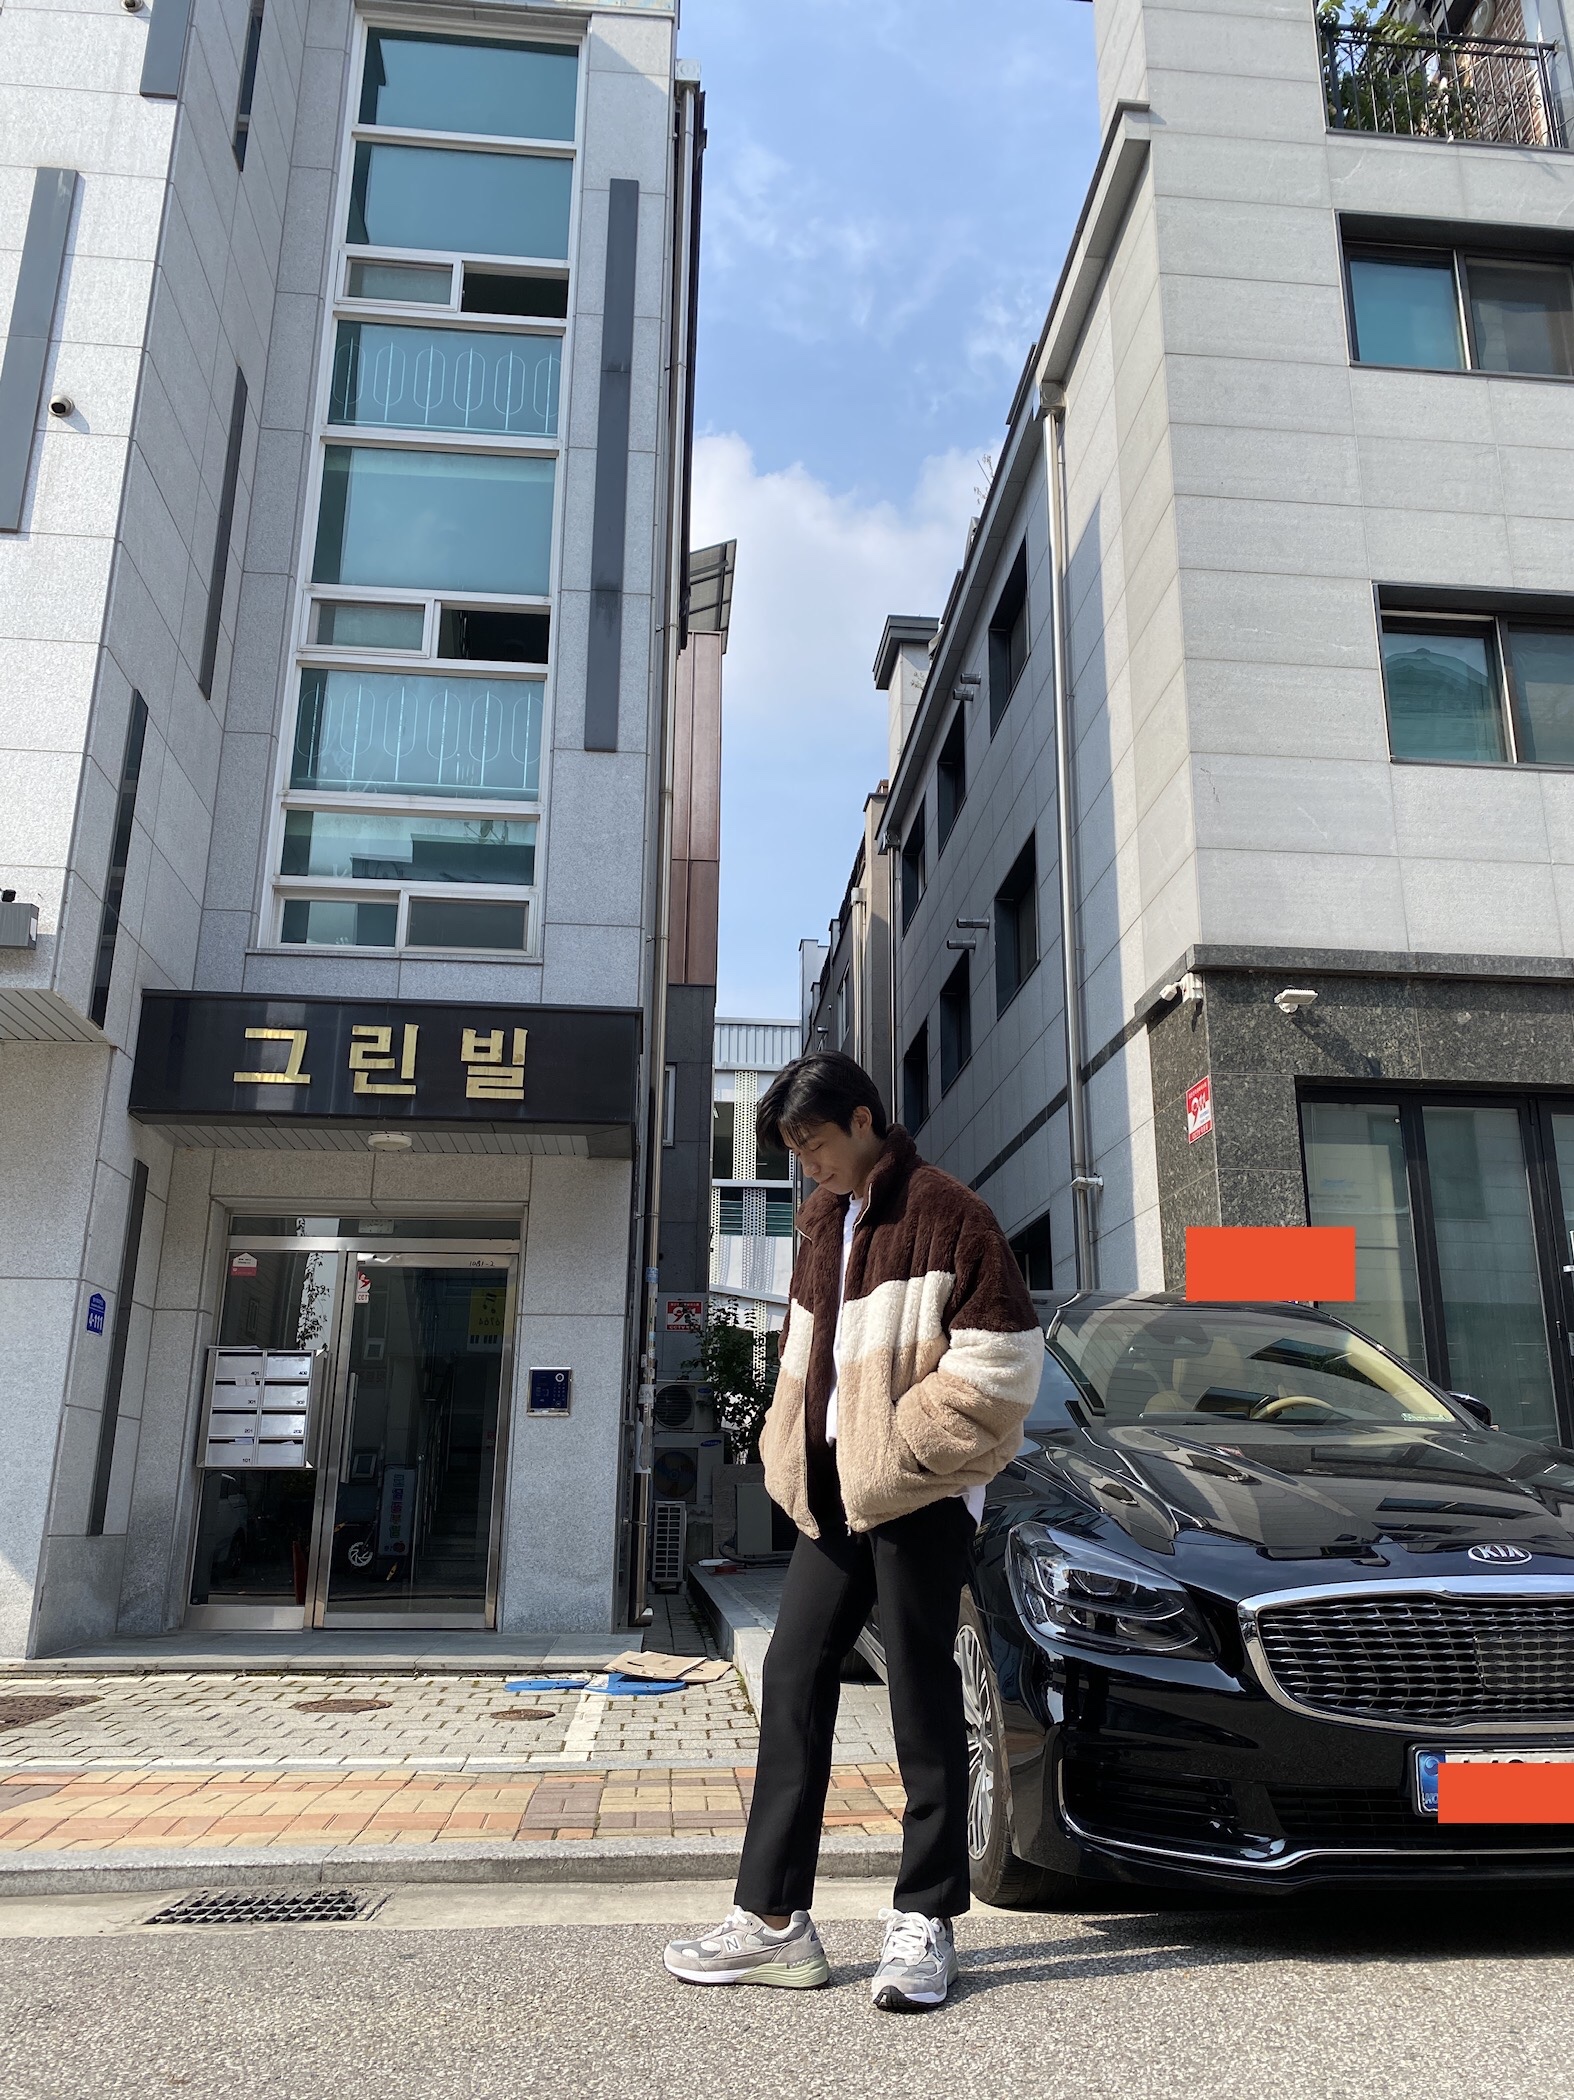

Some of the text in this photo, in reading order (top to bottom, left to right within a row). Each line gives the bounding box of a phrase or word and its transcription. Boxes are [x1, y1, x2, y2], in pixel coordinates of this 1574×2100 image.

[233, 1023, 528, 1100] 그린빌
[1475, 1544, 1527, 1559] KIA
[724, 1936, 740, 1951] N
